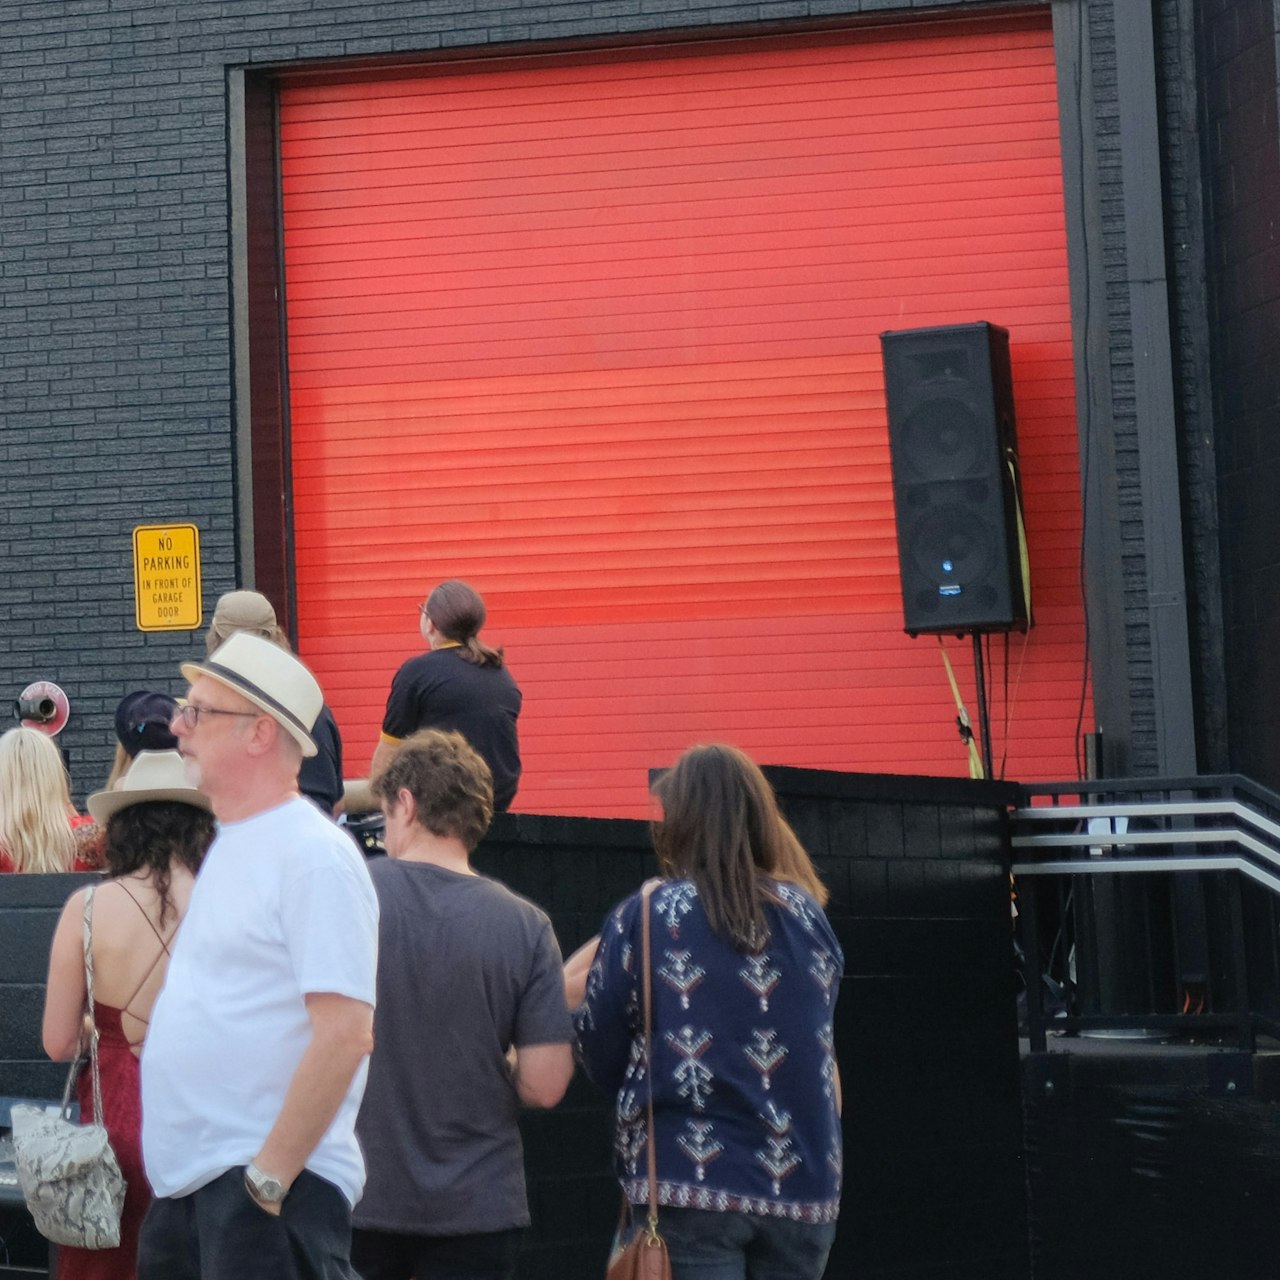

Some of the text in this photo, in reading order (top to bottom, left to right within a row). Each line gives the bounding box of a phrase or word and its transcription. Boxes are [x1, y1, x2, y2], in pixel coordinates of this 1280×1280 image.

[158, 537, 173, 551] NO
[143, 555, 190, 571] PARKING
[143, 577, 192, 590] IN FRONT OF
[152, 591, 183, 604] GARAGE
[157, 606, 179, 618] DOOR
